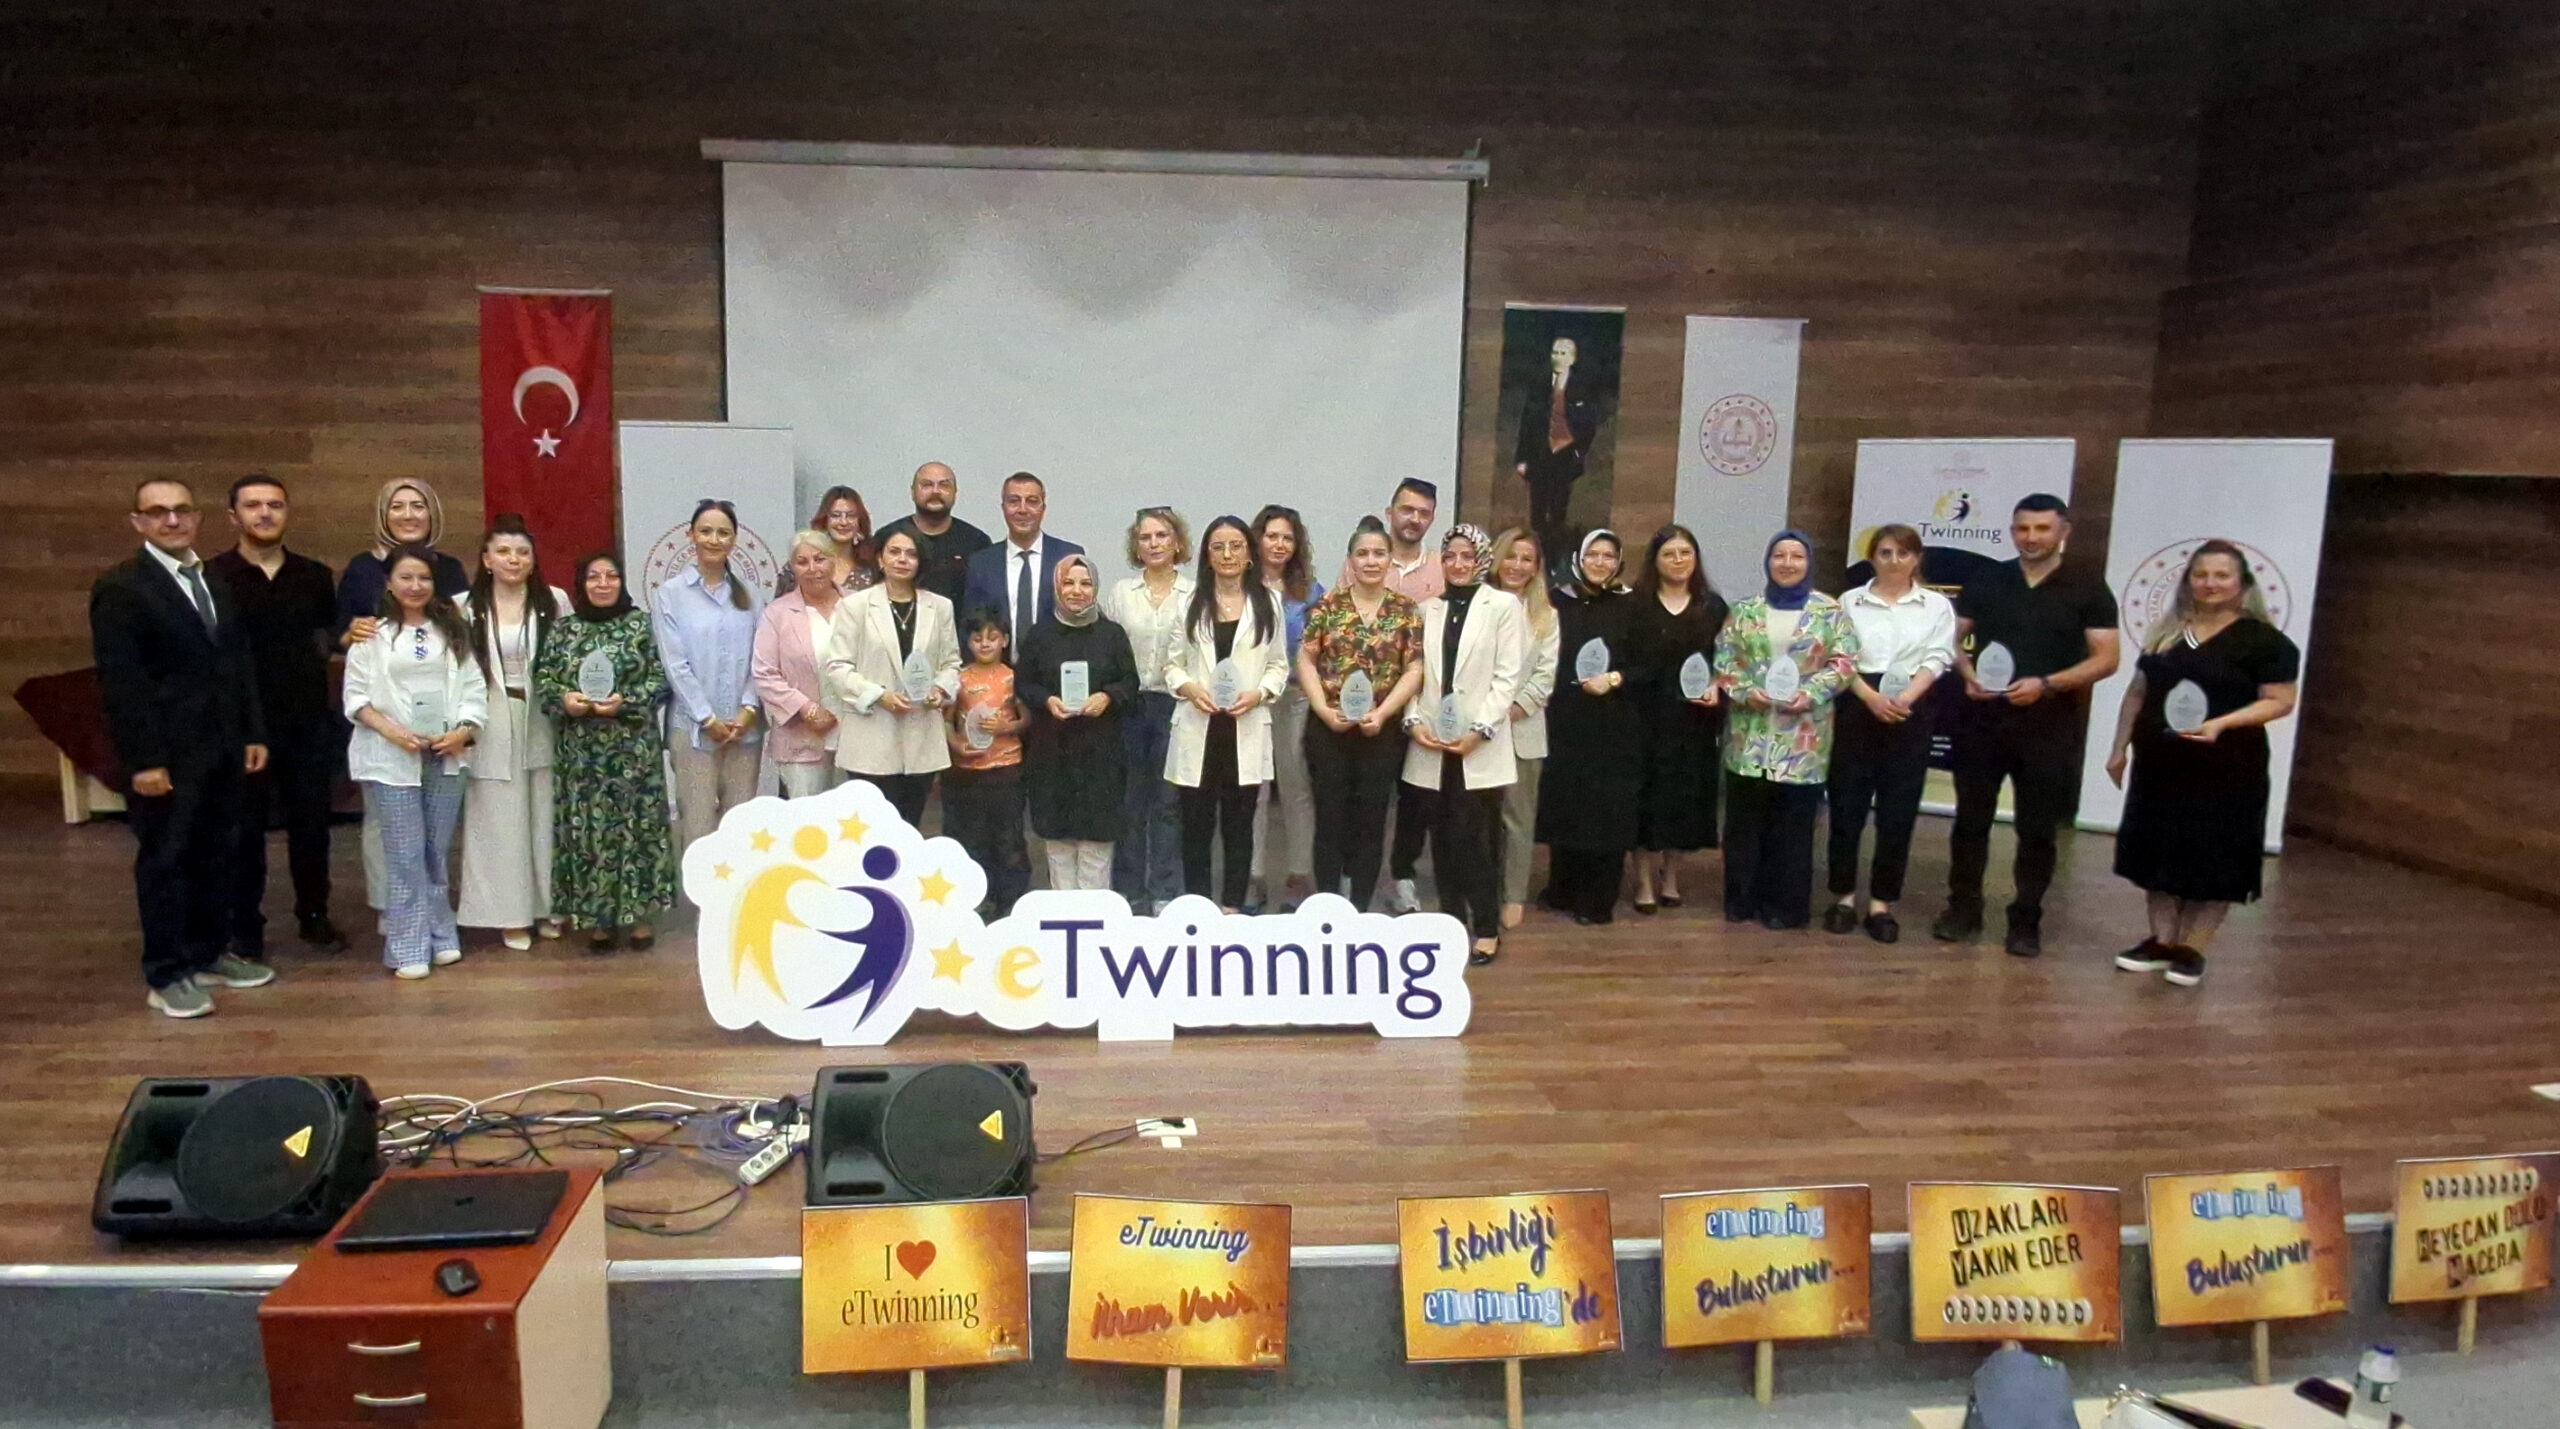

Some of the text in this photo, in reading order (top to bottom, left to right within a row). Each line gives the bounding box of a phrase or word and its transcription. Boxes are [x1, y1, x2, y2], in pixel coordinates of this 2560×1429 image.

[995, 919, 1443, 1020] eTwinning
[1120, 1216, 1250, 1262] eTwinning
[1433, 1206, 1557, 1278] İşbirliği
[1706, 1202, 1826, 1239] eTwinning
[1951, 1197, 2068, 1246] UZAKLARI
[884, 1244, 892, 1281] I
[1950, 1233, 2083, 1286] YAKIN EDER
[842, 1288, 980, 1328] eTwinning
